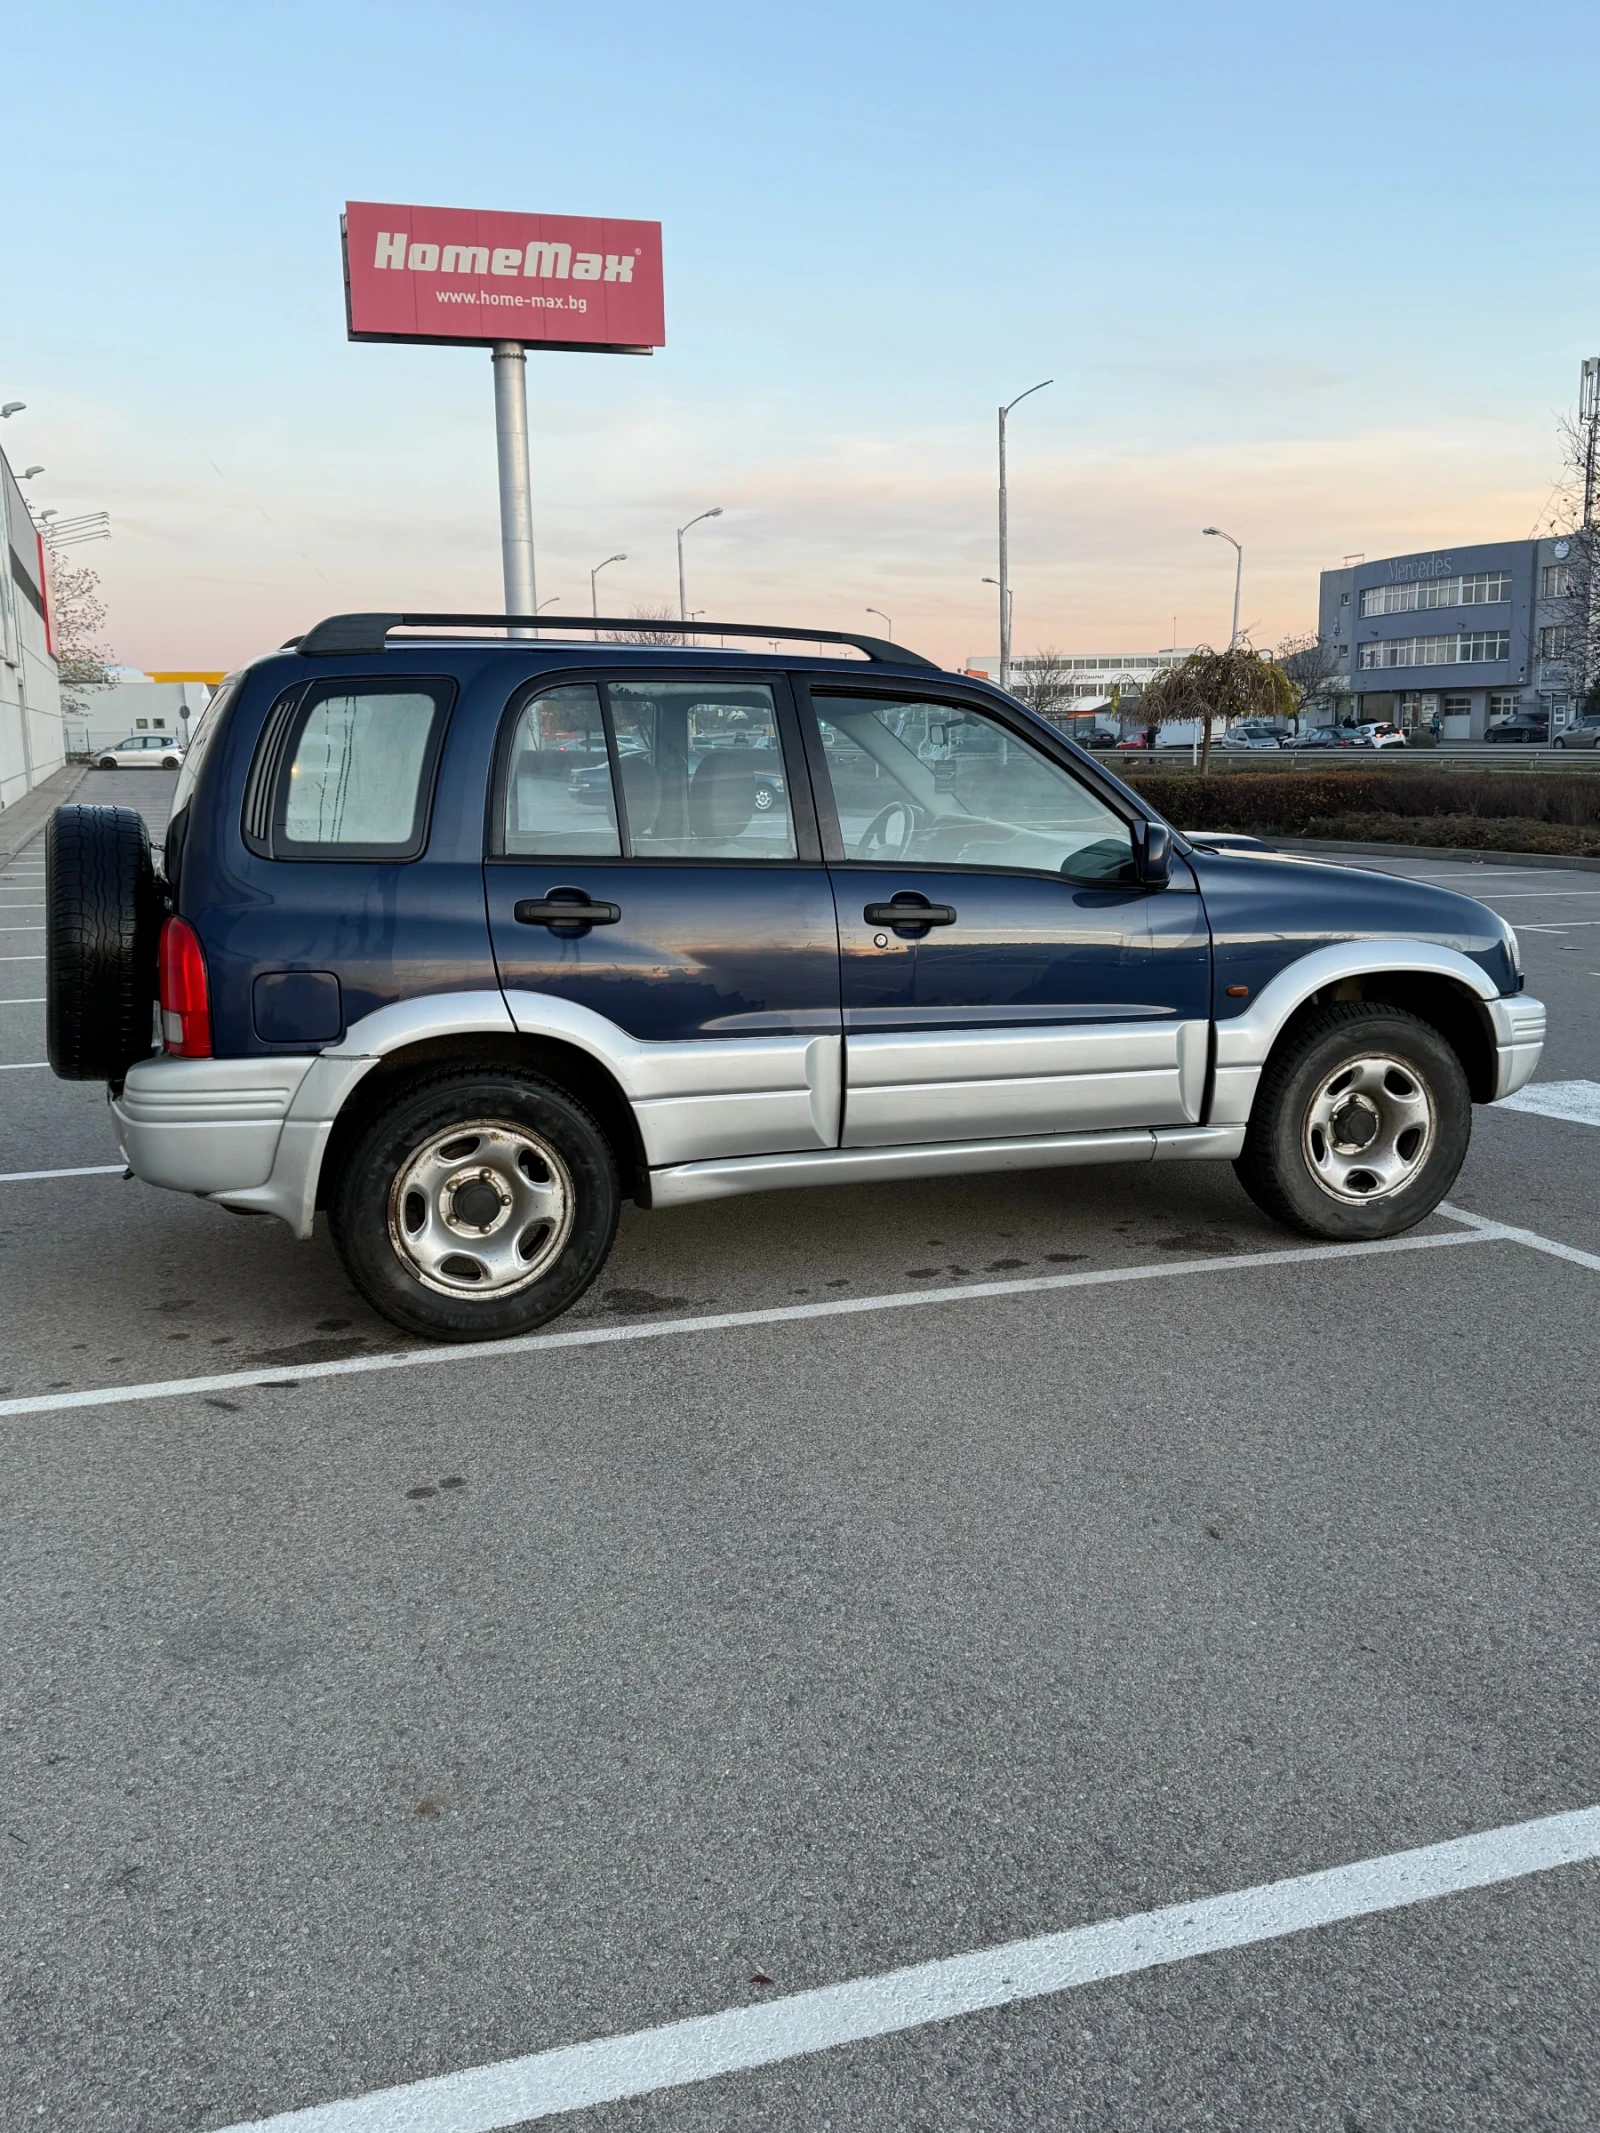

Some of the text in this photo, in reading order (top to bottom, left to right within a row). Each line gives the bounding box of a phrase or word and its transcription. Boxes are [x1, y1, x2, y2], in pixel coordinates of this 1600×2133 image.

[374, 231, 635, 283] HomeMax
[436, 290, 587, 313] www.home-max.bg
[1387, 553, 1452, 582] Mercedes
